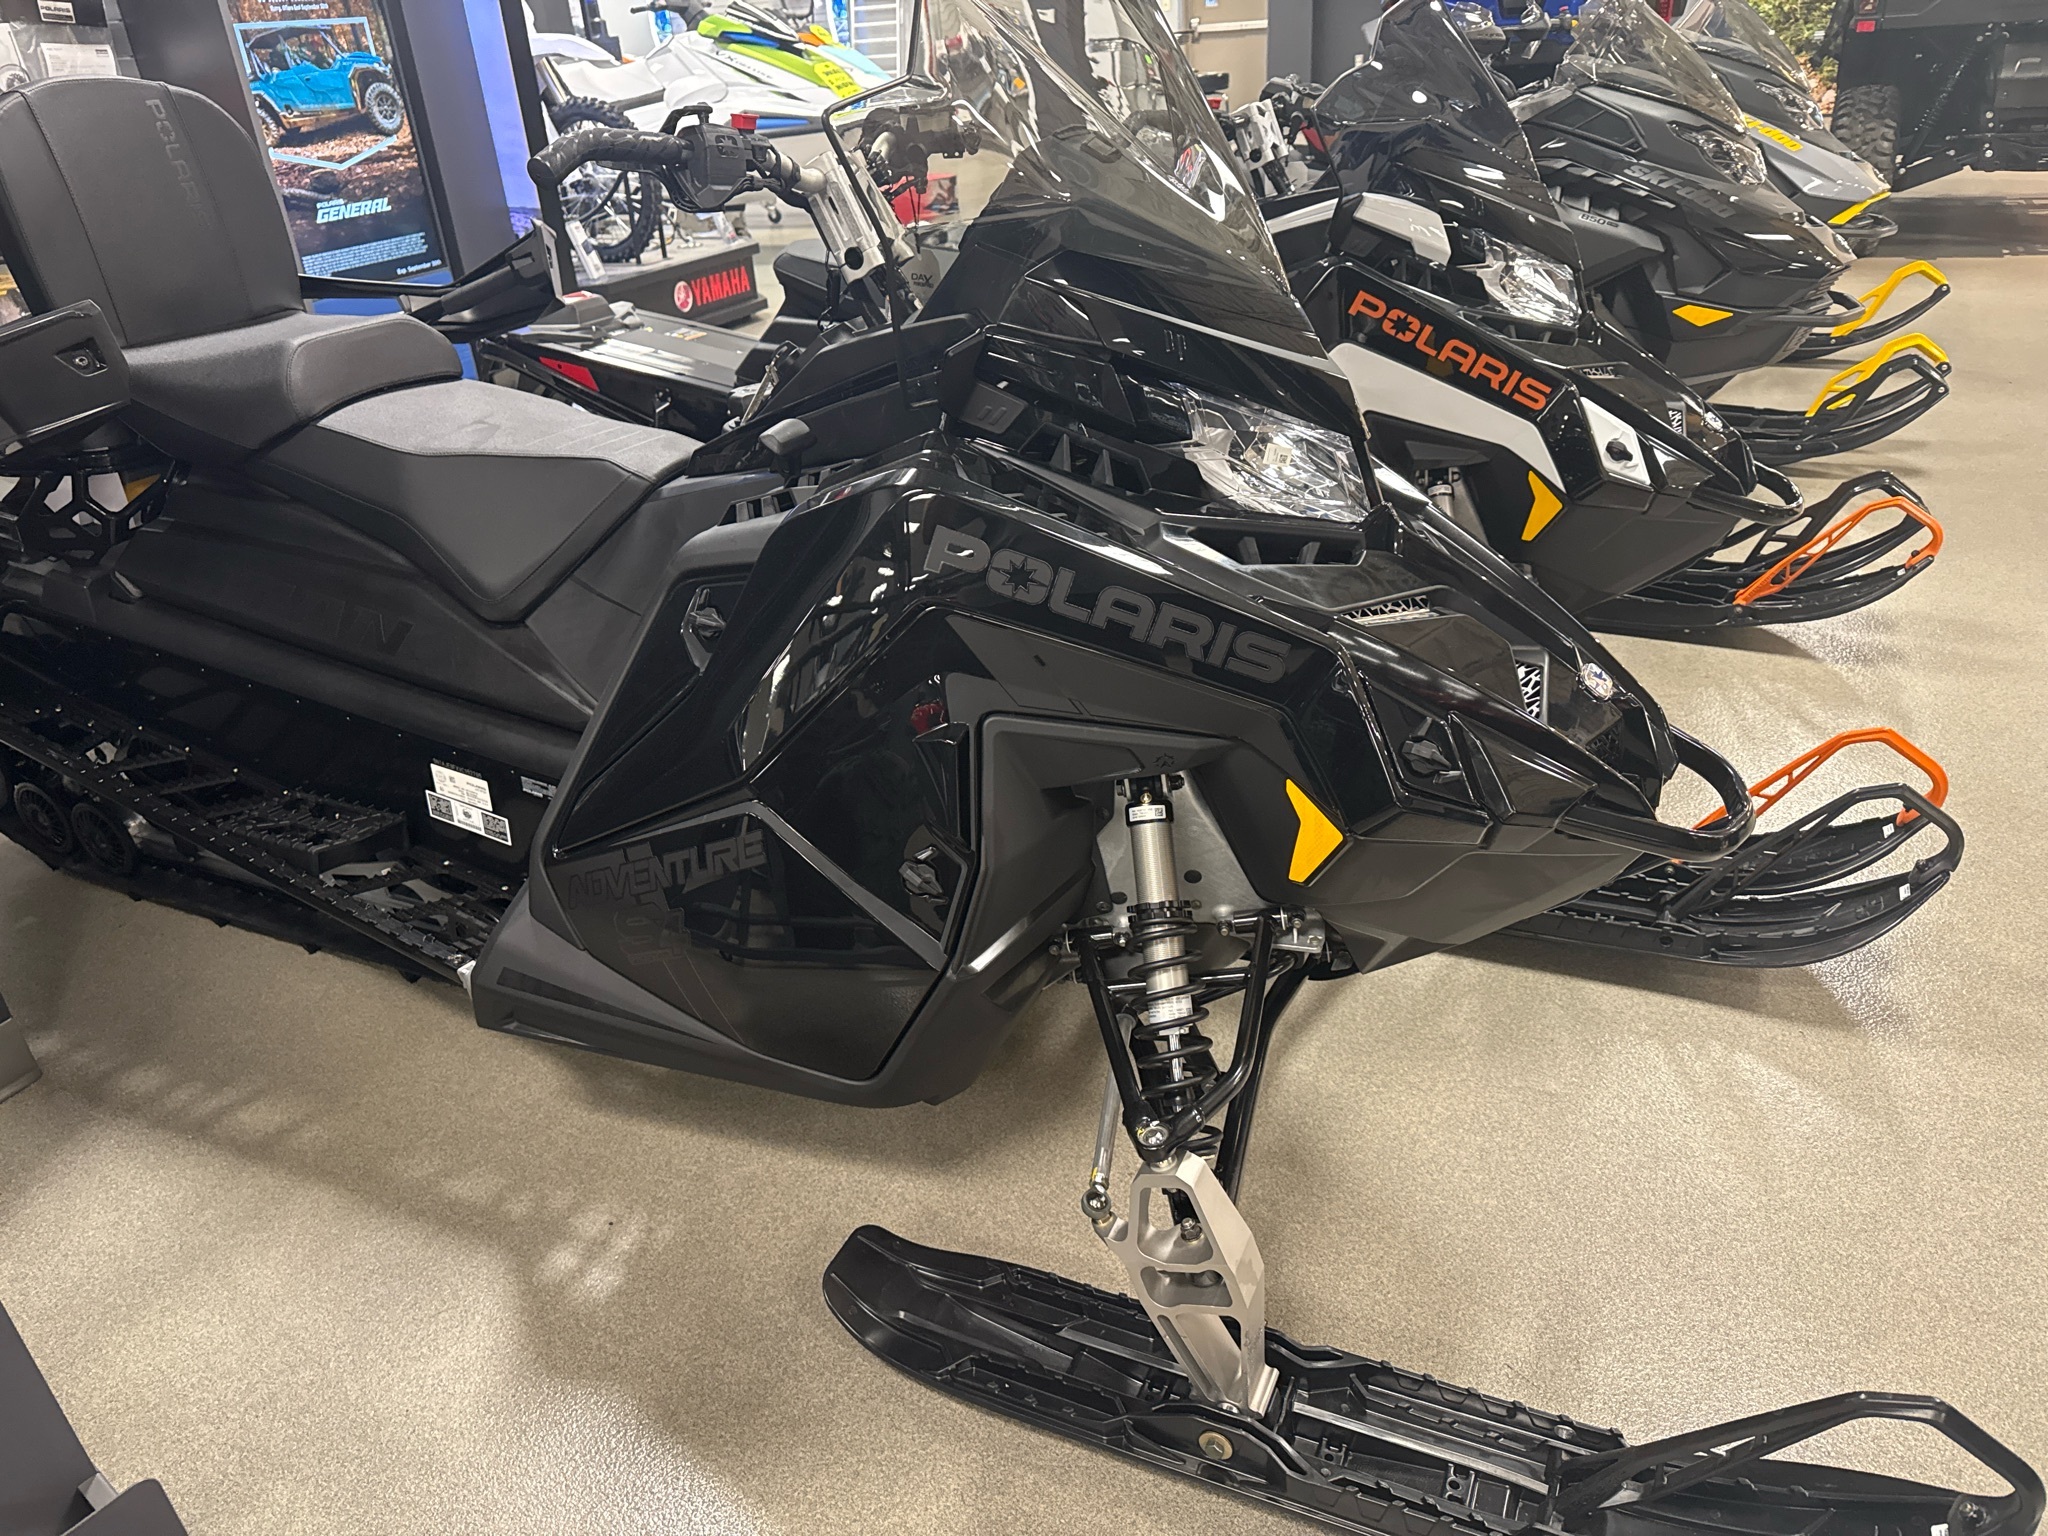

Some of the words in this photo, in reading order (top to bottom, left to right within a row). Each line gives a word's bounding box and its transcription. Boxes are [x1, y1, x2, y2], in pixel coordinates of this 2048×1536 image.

[316, 199, 345, 209] POLARIS
[316, 197, 392, 224] GENERAL
[1580, 213, 1606, 225] 850
[690, 266, 751, 306] YAMAHA
[1348, 290, 1552, 411] POLARIS
[923, 525, 1292, 685] POLARIS
[569, 829, 768, 910] ADVENTURE
